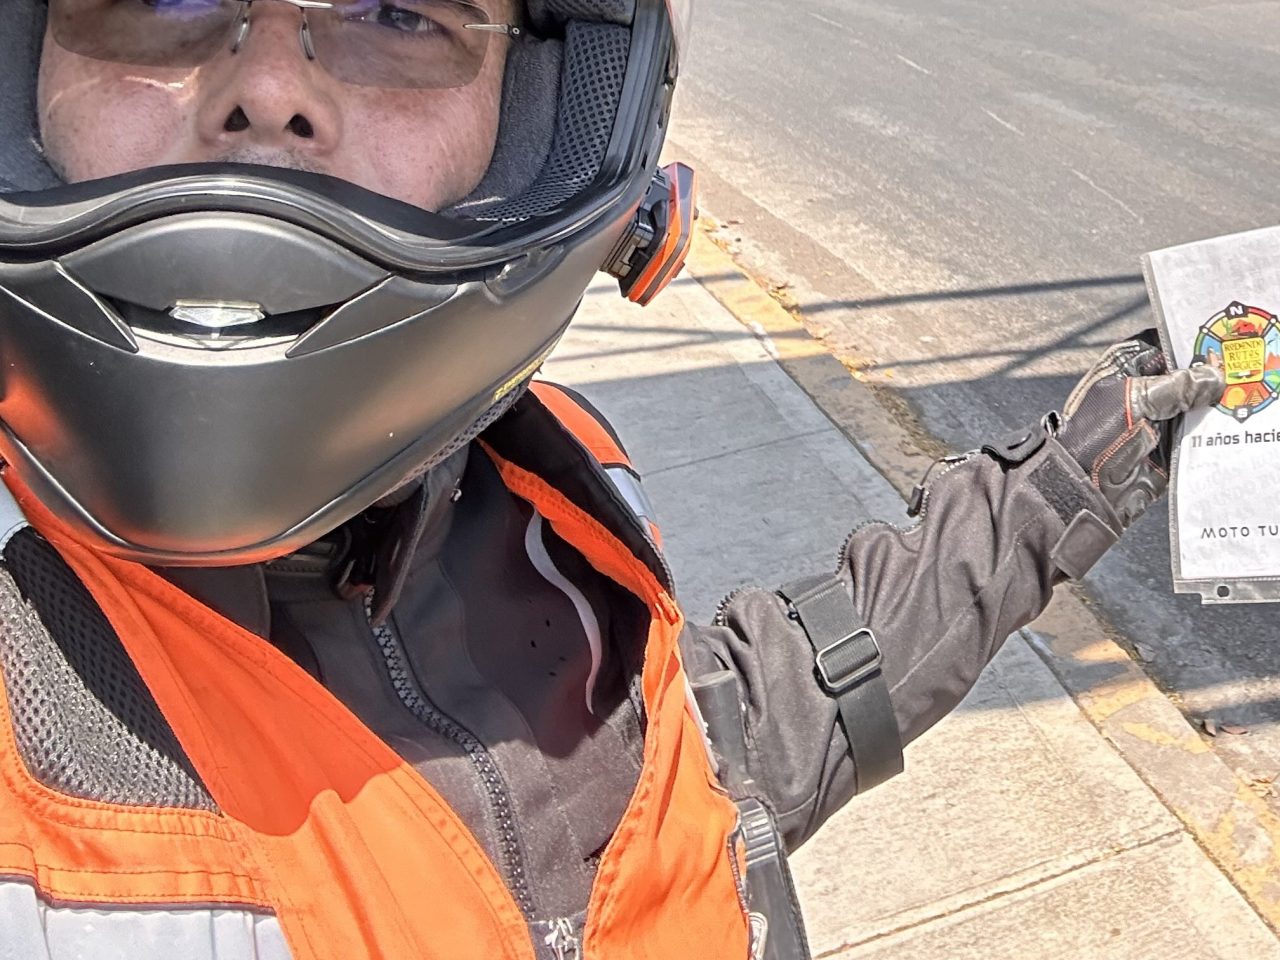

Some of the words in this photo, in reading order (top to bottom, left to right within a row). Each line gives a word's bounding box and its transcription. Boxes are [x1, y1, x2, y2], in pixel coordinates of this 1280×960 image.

[1191, 435, 1202, 448] 11
[1206, 432, 1240, 447] años
[1201, 526, 1250, 539] MOTO
